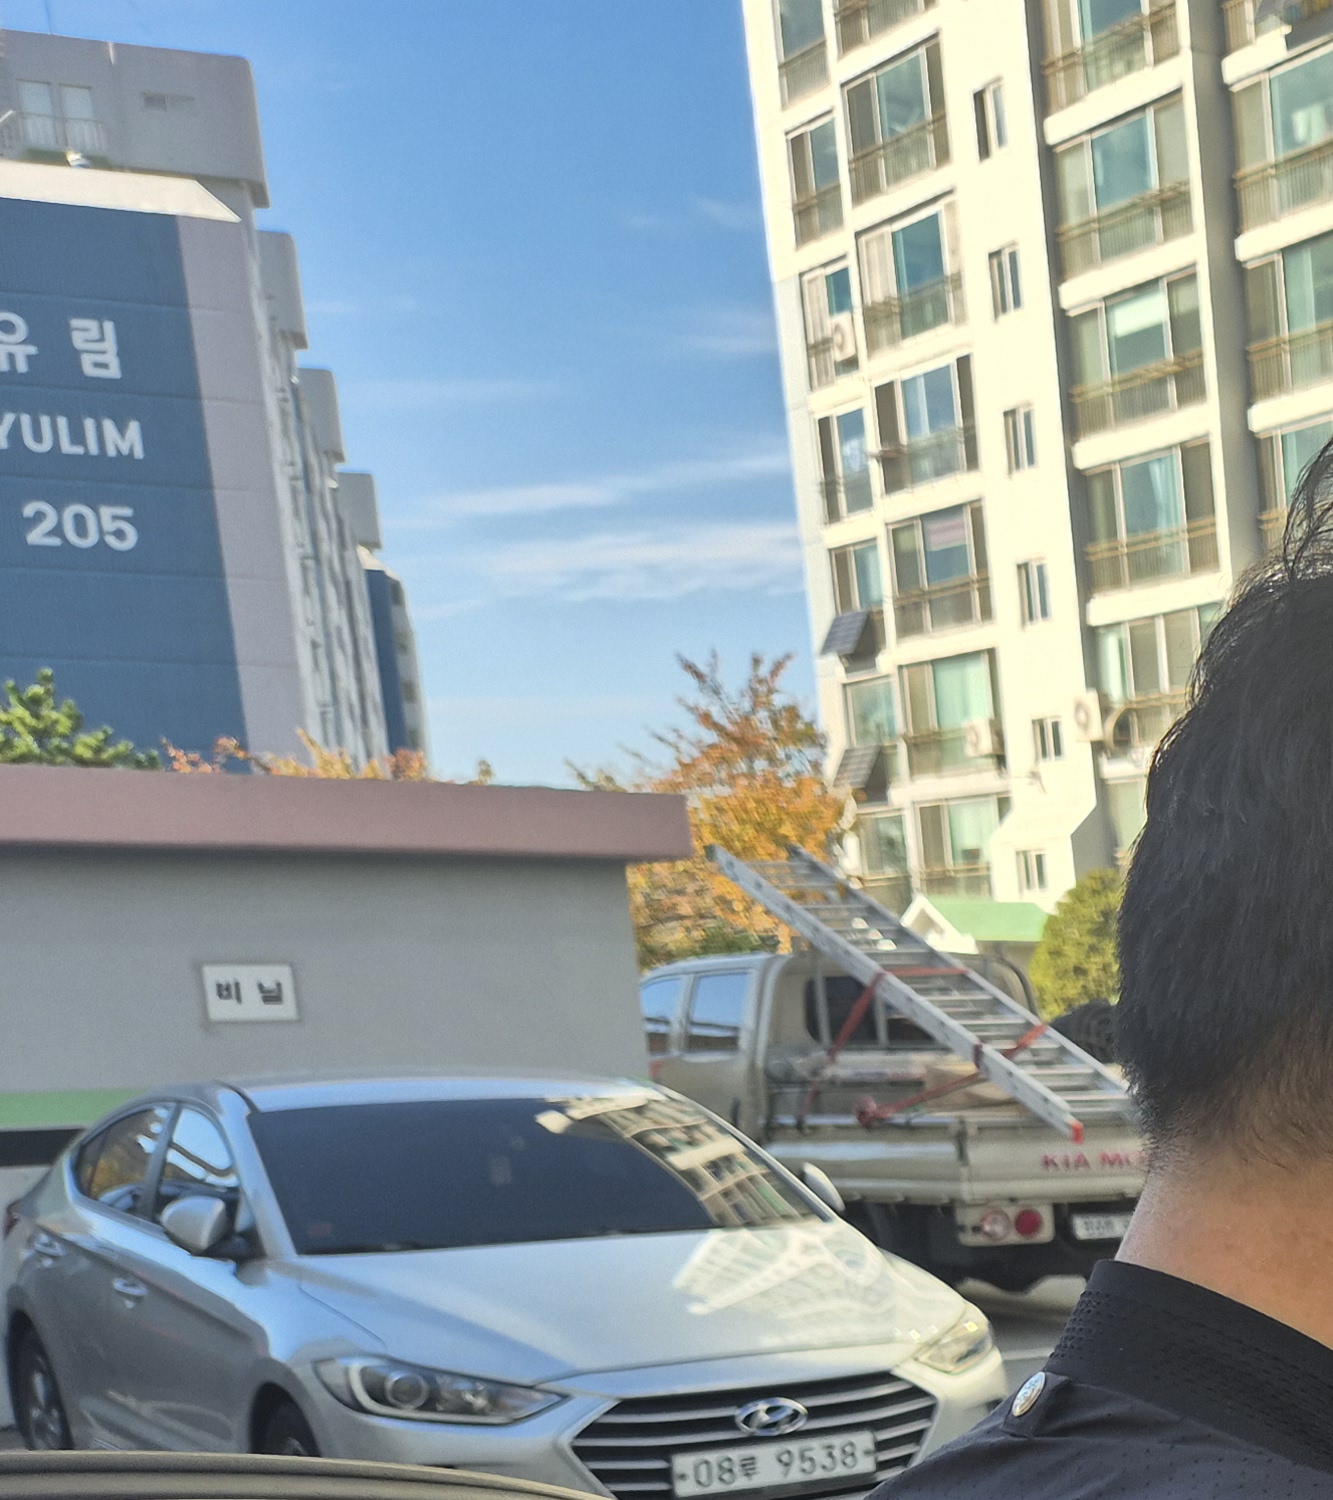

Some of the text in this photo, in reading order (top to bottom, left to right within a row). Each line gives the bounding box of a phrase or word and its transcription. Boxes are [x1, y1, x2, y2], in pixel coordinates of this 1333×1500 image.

[0, 412, 144, 460] YULIM
[22, 500, 139, 551] 205
[1041, 1152, 1091, 1171] KIA
[775, 1440, 857, 1479] 9538
